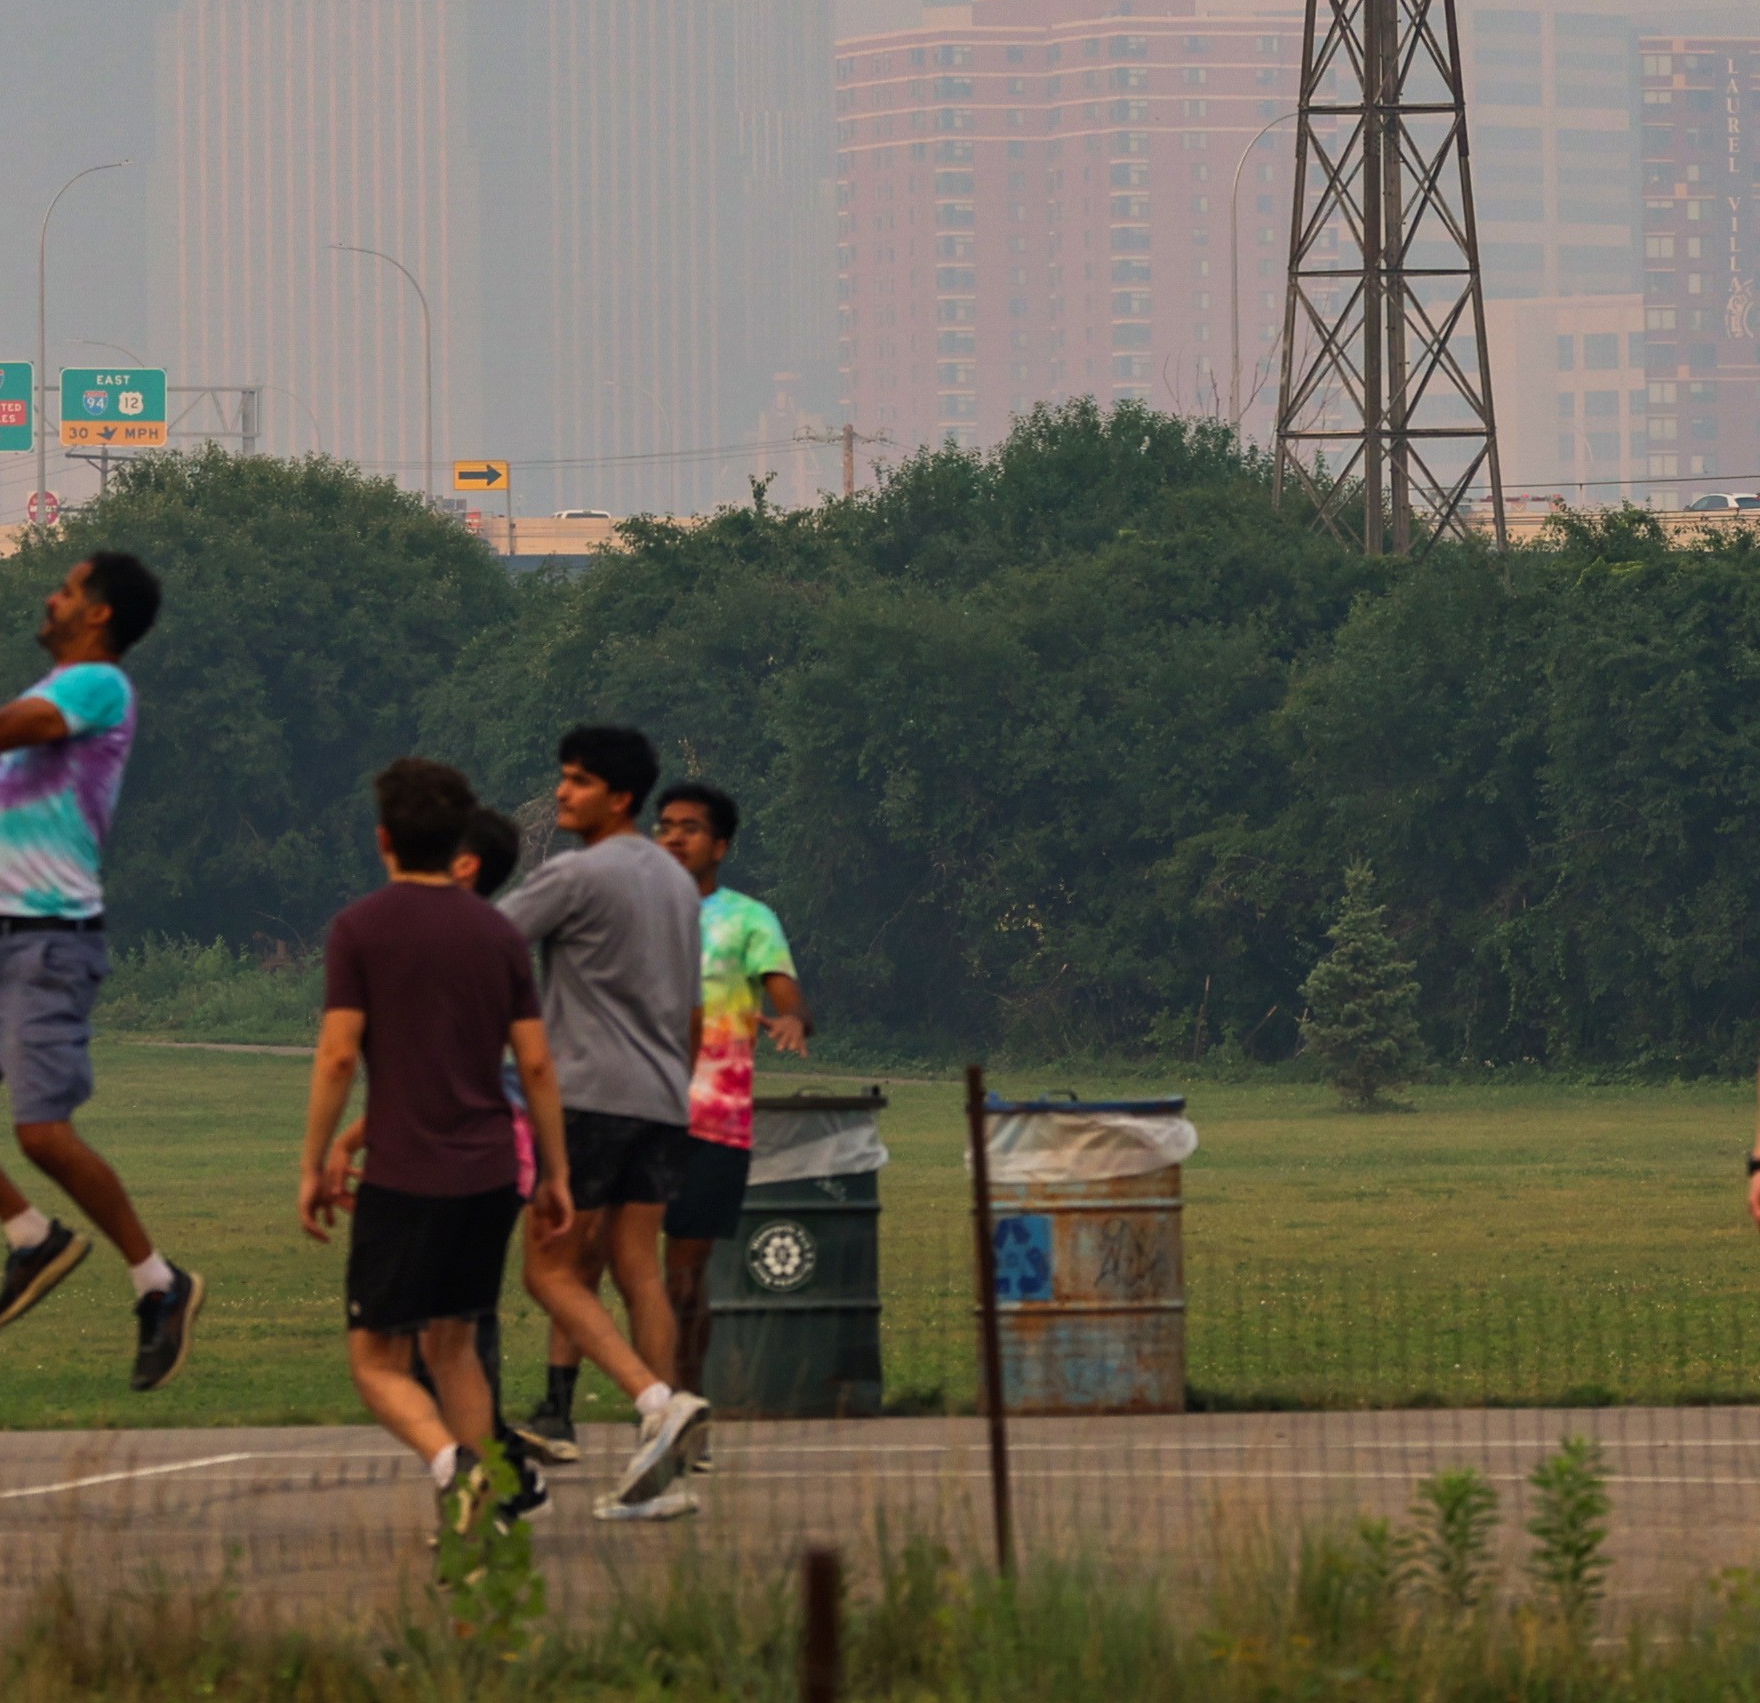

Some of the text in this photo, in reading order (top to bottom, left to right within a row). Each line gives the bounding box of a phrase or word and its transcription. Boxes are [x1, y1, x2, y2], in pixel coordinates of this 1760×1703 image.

[1726, 58, 1743, 291] LAUREL VILLA
[96, 375, 131, 386] EAST
[86, 398, 139, 410] 94 12
[69, 427, 159, 439] 30 MPH
